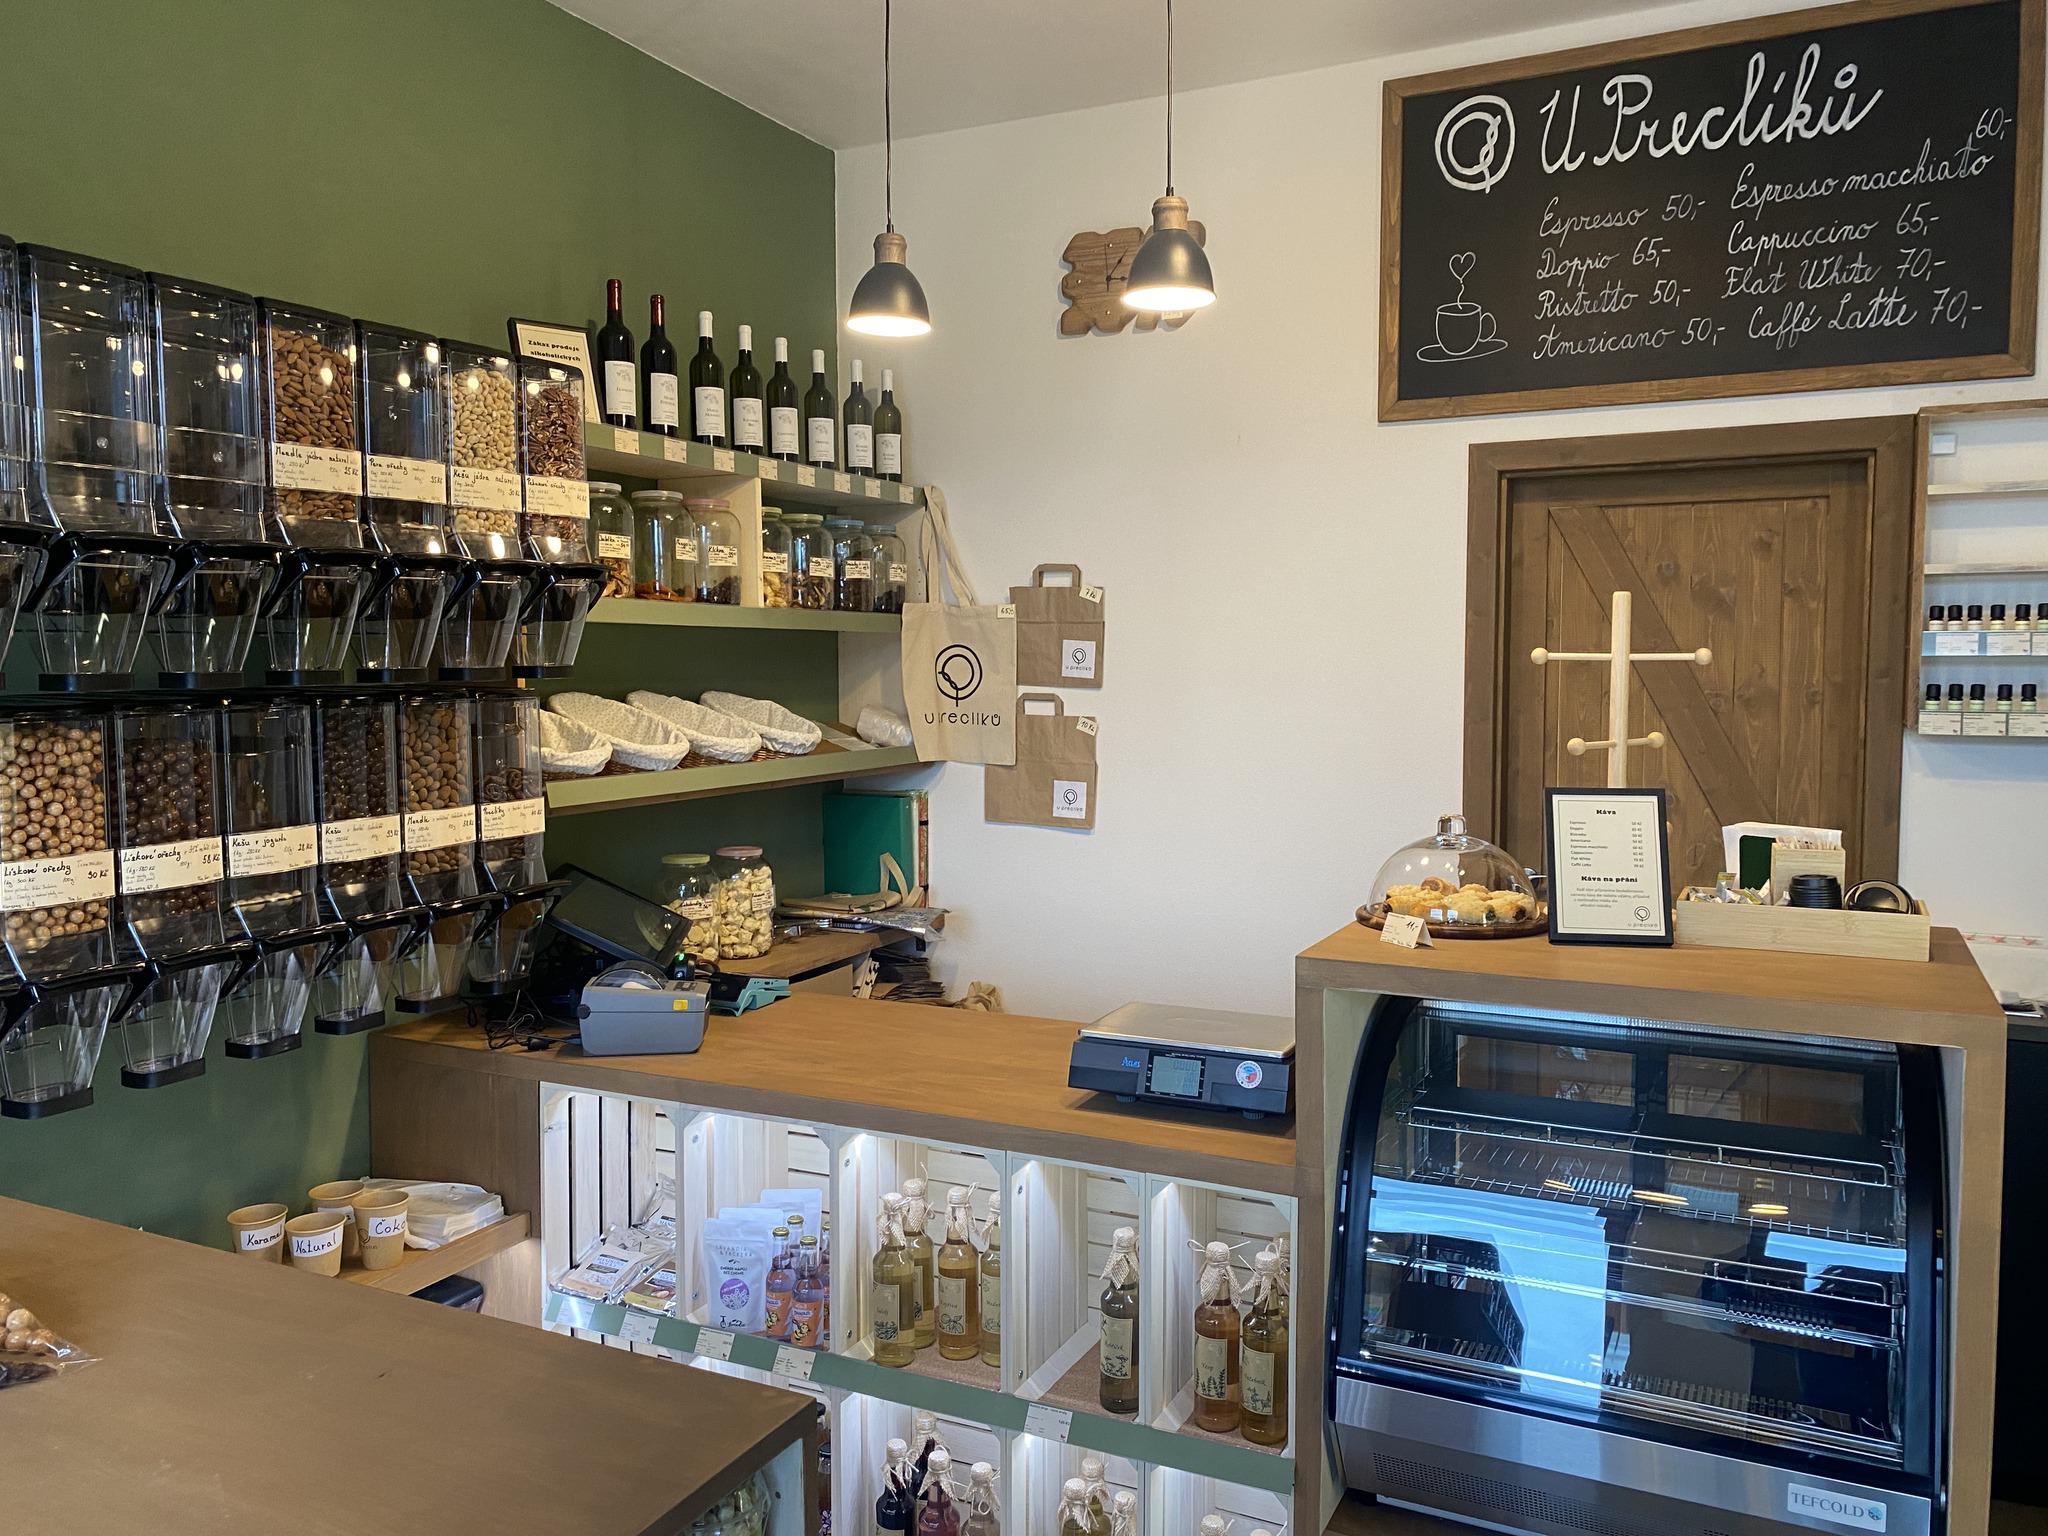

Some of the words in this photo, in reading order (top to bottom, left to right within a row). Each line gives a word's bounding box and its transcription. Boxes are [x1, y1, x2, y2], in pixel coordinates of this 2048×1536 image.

[1540, 86, 1589, 174] U
[1976, 106, 2013, 140] 60,-
[1730, 163, 1840, 213] Espresso
[1843, 136, 1994, 194] macchiato
[1539, 198, 1649, 240] Espresso
[1662, 194, 1707, 222] 50,-
[1727, 220, 1879, 266] Cappuccino
[1895, 202, 1939, 237] 65,-
[1537, 250, 1621, 287] Doppio
[1632, 238, 1672, 267] 65,-
[1721, 267, 1787, 299] Flat
[1799, 258, 1883, 291] White
[1896, 248, 1946, 281] 70,-
[1535, 280, 1639, 321] Ristretto
[1649, 280, 1692, 308] 50,-
[1828, 288, 1918, 330] Latte
[1930, 289, 1982, 328] 70,-
[1533, 327, 1669, 362] Americano
[1681, 318, 1727, 346] 50,-
[4, 863, 38, 877] Lískové
[42, 861, 72, 876] ořechy
[123, 848, 157, 862] Lískové
[157, 846, 181, 862] ořechy
[246, 1224, 283, 1247] Karamel
[296, 1232, 337, 1255] Natural
[1791, 1492, 1865, 1518] TEFCOLD
